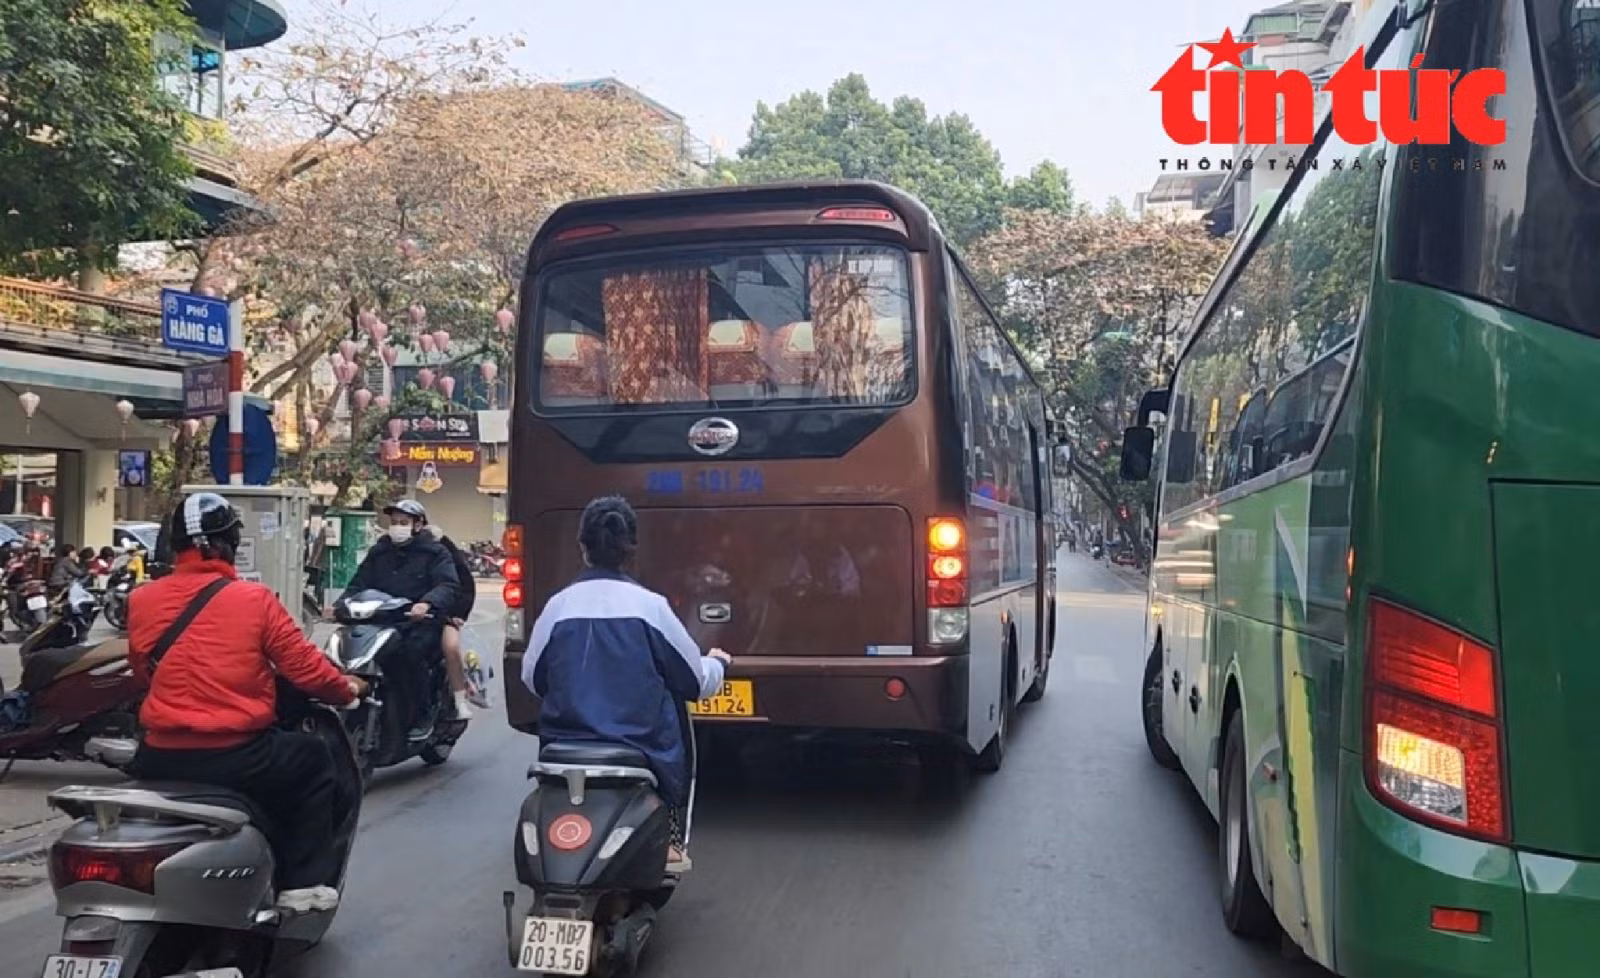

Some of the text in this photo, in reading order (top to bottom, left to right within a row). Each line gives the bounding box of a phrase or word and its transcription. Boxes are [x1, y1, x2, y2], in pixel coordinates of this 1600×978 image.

[186, 303, 209, 318] PHỐ
[169, 315, 225, 346] HÀNG GÀ
[522, 945, 585, 971] 003.56
